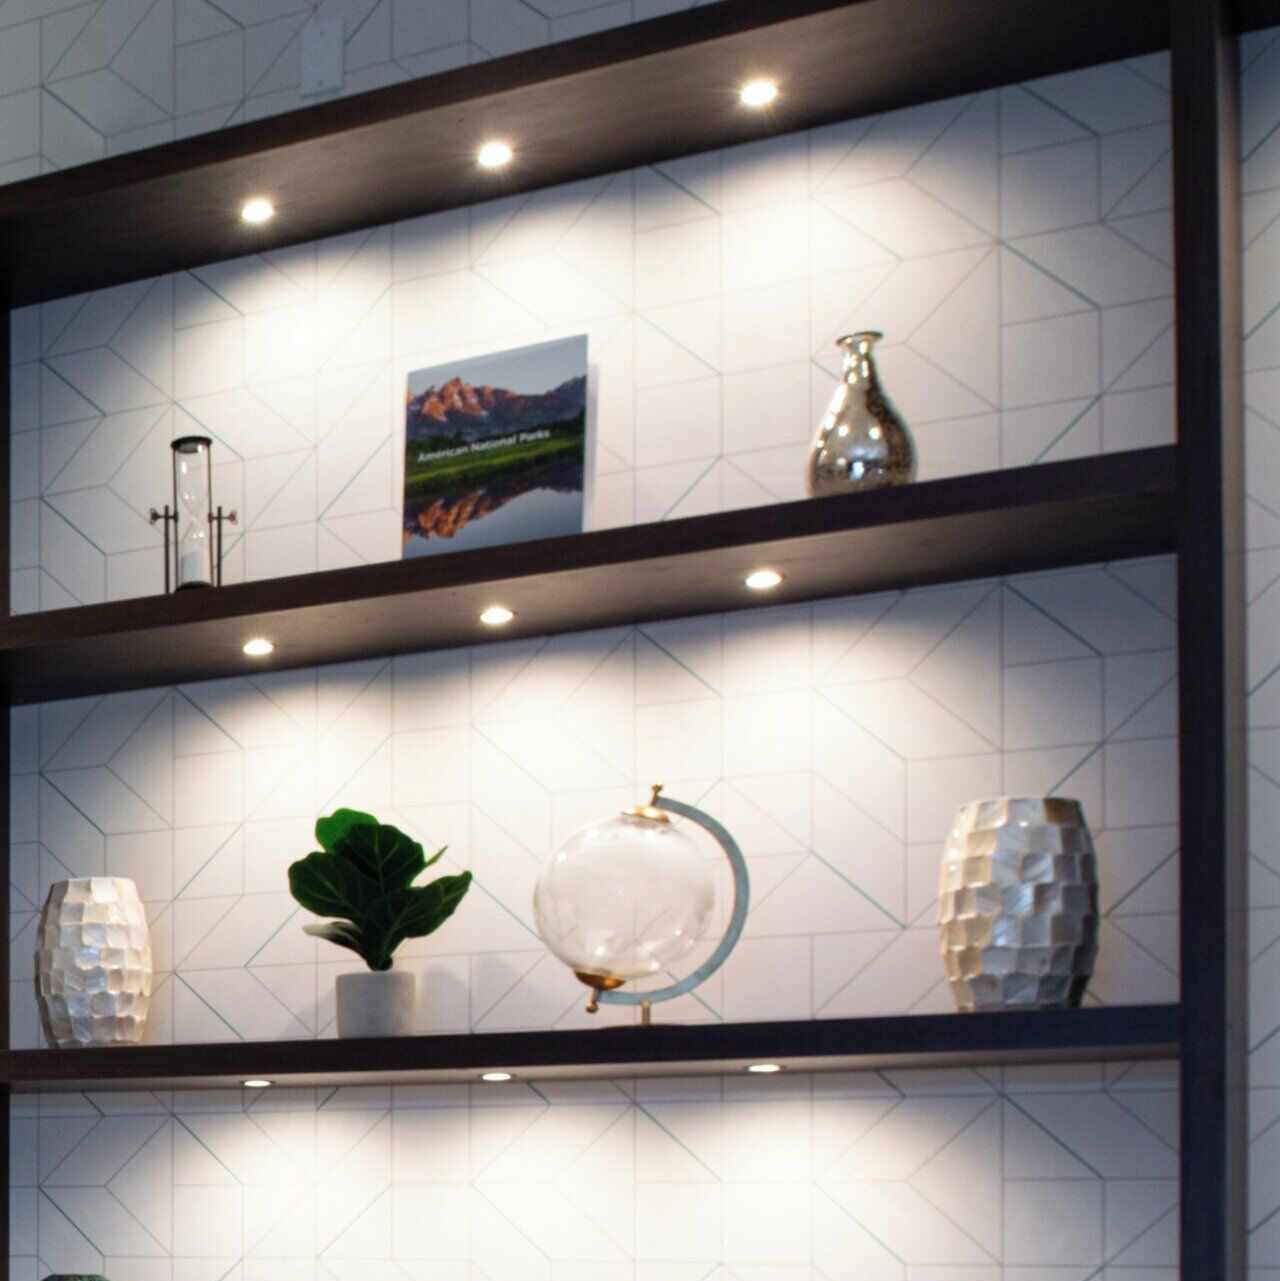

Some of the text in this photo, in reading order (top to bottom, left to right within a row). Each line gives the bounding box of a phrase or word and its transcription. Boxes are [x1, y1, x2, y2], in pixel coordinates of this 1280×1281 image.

[417, 429, 550, 463] American National Parks
